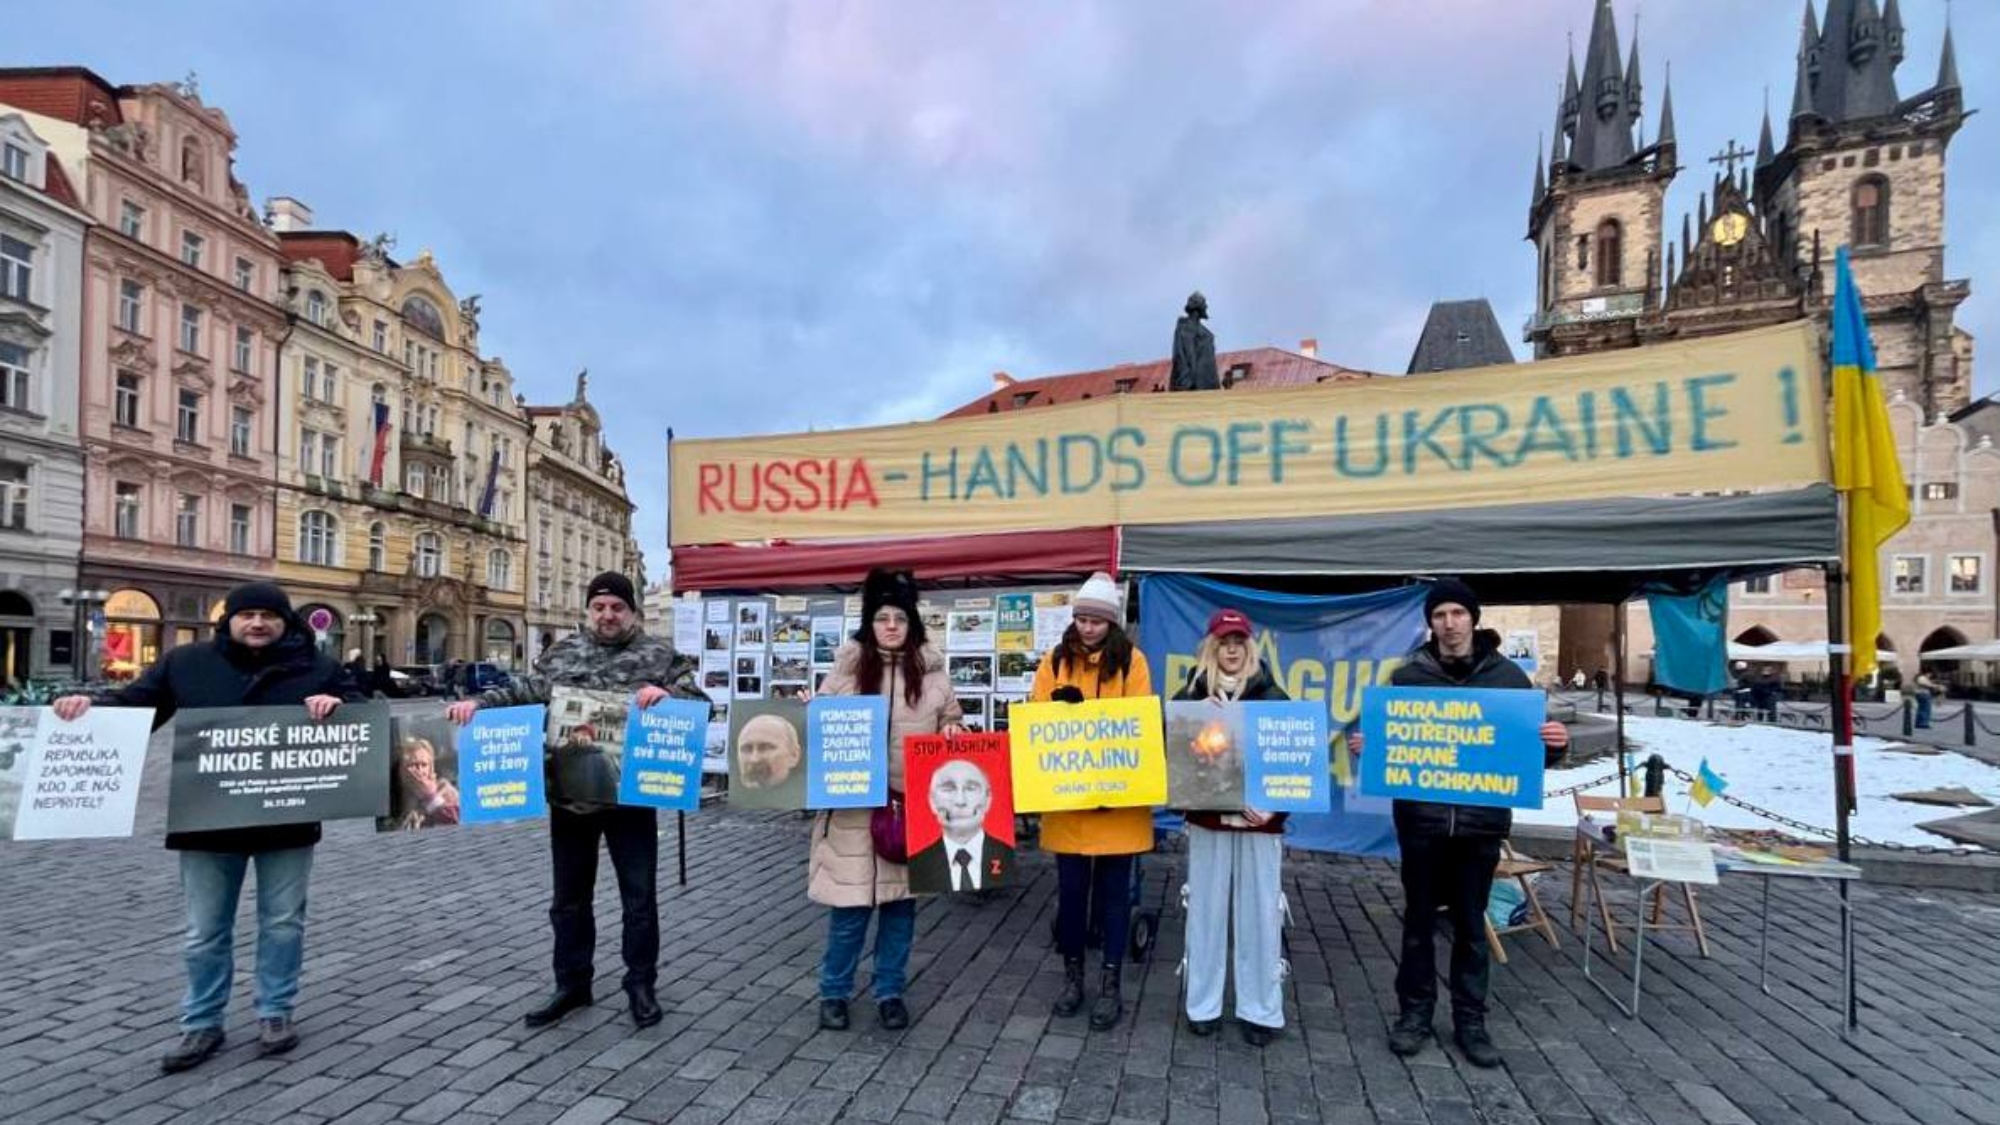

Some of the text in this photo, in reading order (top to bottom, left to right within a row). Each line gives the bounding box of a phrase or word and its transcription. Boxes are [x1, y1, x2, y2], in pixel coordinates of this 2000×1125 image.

[697, 457, 880, 516] RUSSIA
[921, 425, 1146, 501] HANDS
[1168, 418, 1310, 487] OFF
[1334, 373, 1736, 478] UKRAINE
[1001, 610, 1030, 621] HELP
[1386, 700, 1483, 720] UKRAJINA
[641, 712, 696, 732] Ukrajinci
[1029, 711, 1142, 745] PODPOŘME
[1257, 717, 1315, 734] Ukrajinci
[287, 722, 371, 743] HRANICE
[473, 723, 531, 741] Ukrajinci
[647, 731, 685, 746] chrání
[1258, 733, 1316, 747] brání své
[1386, 719, 1496, 745] POTŘEBUJE
[44, 748, 119, 762] REPUBLIKA
[481, 740, 522, 755] chrání
[633, 745, 696, 766] své matky
[913, 741, 943, 756] STOP
[199, 750, 263, 774] NIKDE
[474, 756, 528, 773] své ženy
[1262, 749, 1311, 766] domovy
[37, 777, 121, 793] KDO JE NÁŠ
[1386, 768, 1519, 796] NA OCHRANU!
[990, 859, 1001, 873] Z
